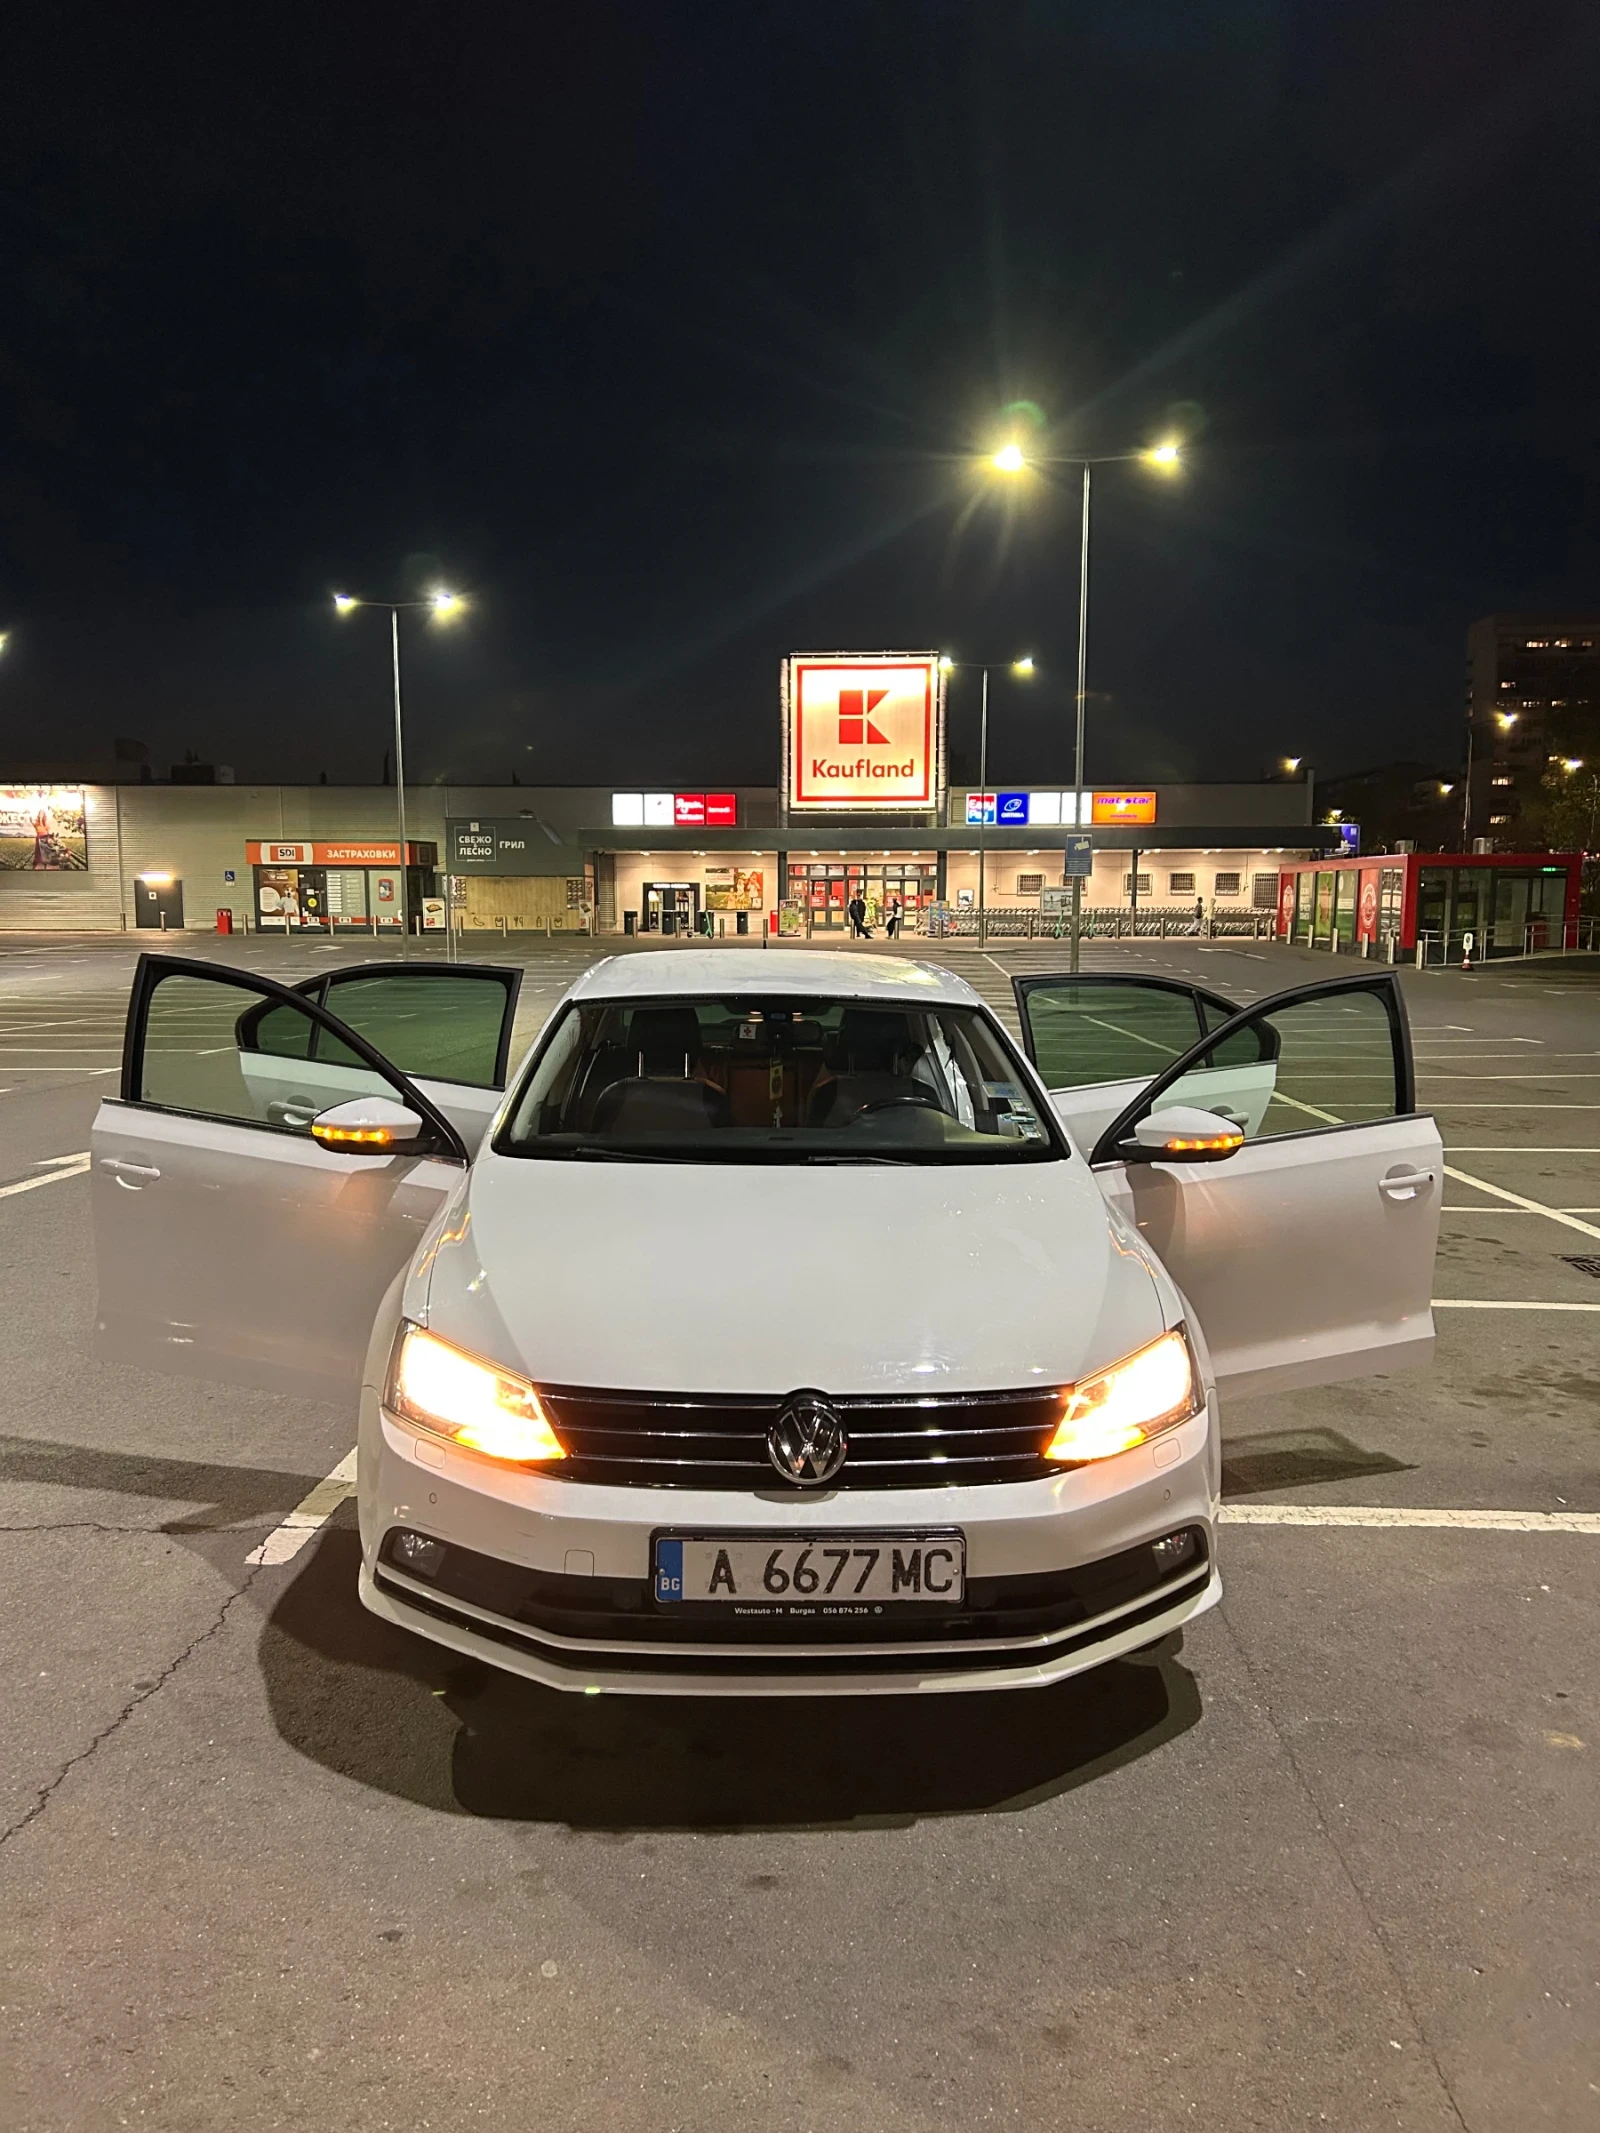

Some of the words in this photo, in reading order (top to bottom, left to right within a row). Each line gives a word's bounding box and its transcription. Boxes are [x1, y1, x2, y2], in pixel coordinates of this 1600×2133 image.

[812, 759, 914, 778] Kaufland
[458, 836, 492, 844] СВЕЖО
[499, 841, 525, 849] ГРИЛ
[278, 848, 294, 857] SDI
[326, 849, 395, 859] ЗАСТРАХОВКИ
[459, 847, 492, 856] ЛЕСНО
[708, 1548, 737, 1594] A
[763, 1548, 880, 1594] 6677
[891, 1547, 953, 1594] MC
[660, 1577, 680, 1592] BG
[789, 1607, 816, 1616] Burgas
